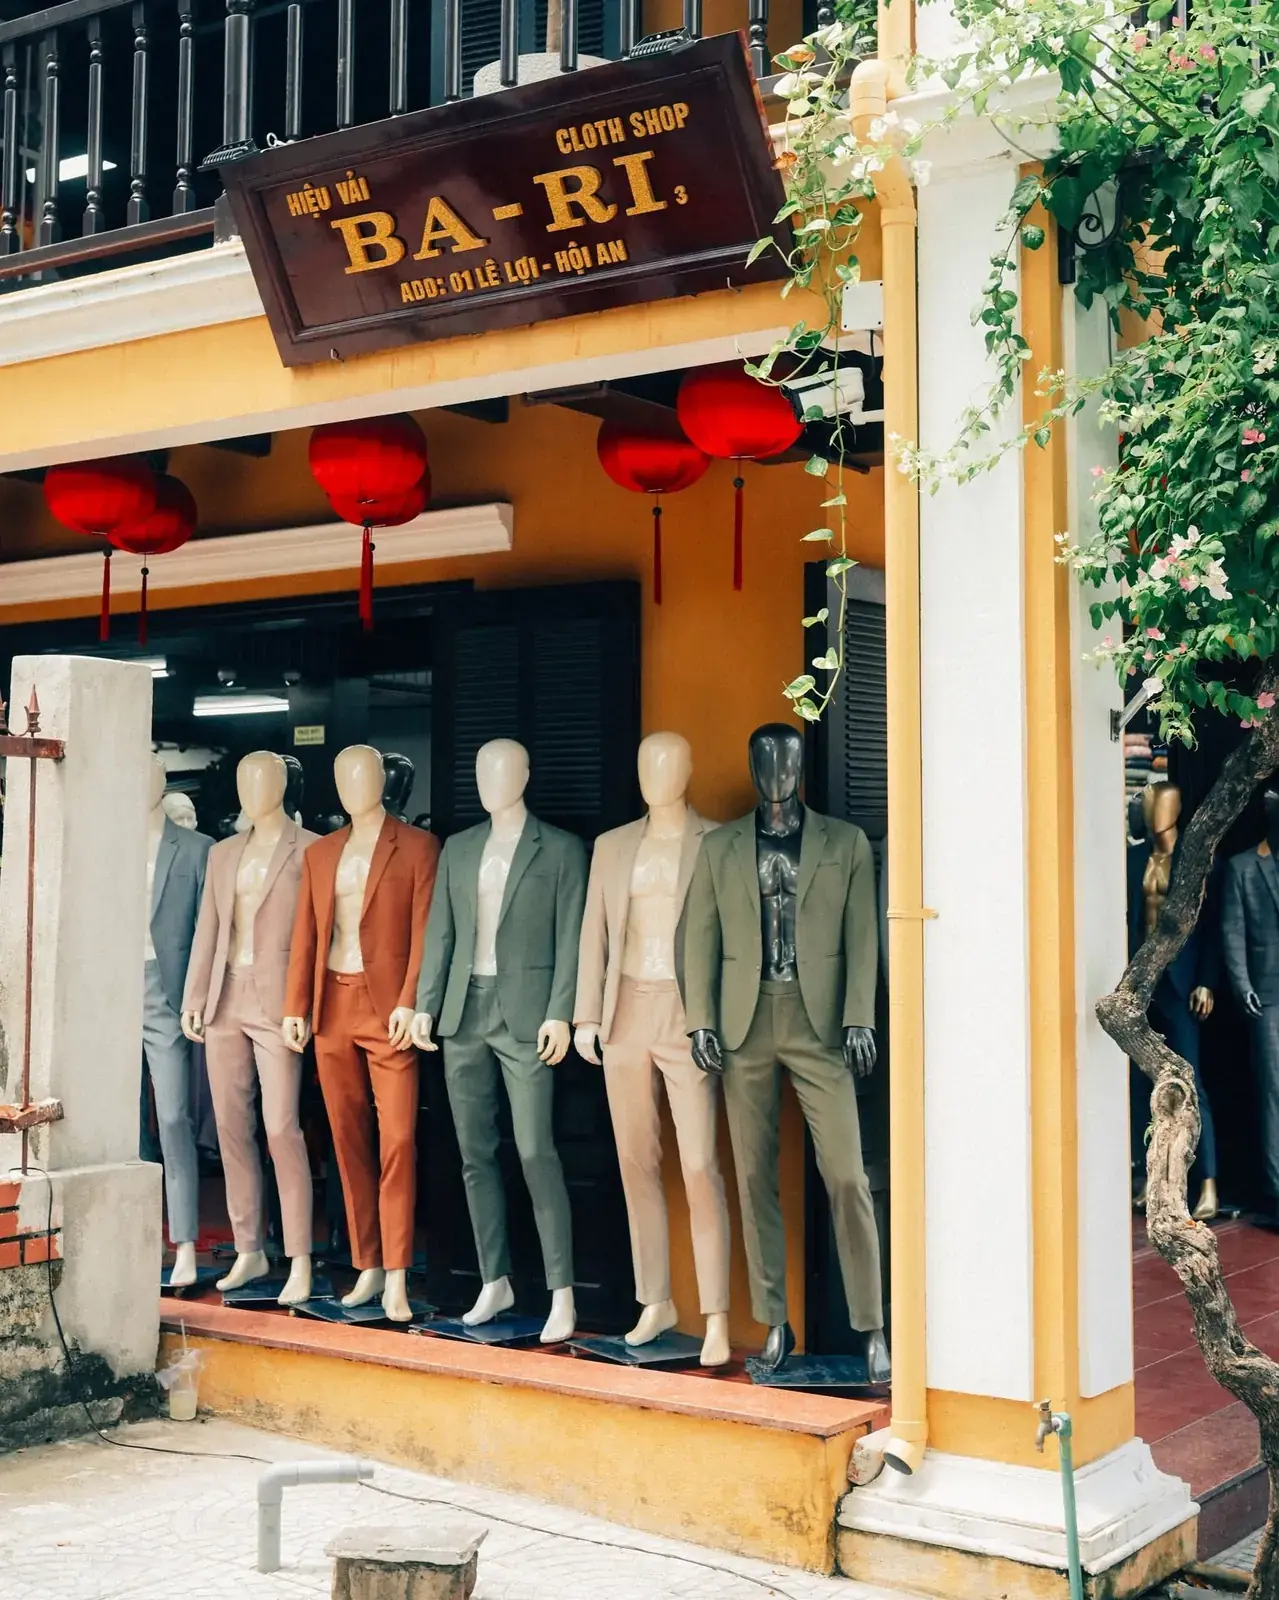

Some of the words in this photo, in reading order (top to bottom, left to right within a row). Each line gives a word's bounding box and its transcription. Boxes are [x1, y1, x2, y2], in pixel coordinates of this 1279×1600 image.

[556, 116, 626, 154] CLOTH
[629, 102, 689, 138] SHOP
[286, 182, 332, 219] HIỆU
[335, 169, 371, 205] VẢI
[674, 185, 689, 205] 3
[400, 277, 447, 303] ADD:
[449, 270, 474, 293] 01
[475, 258, 501, 288] LÊ
[554, 240, 592, 275] HỘI
[596, 239, 629, 266] AN
